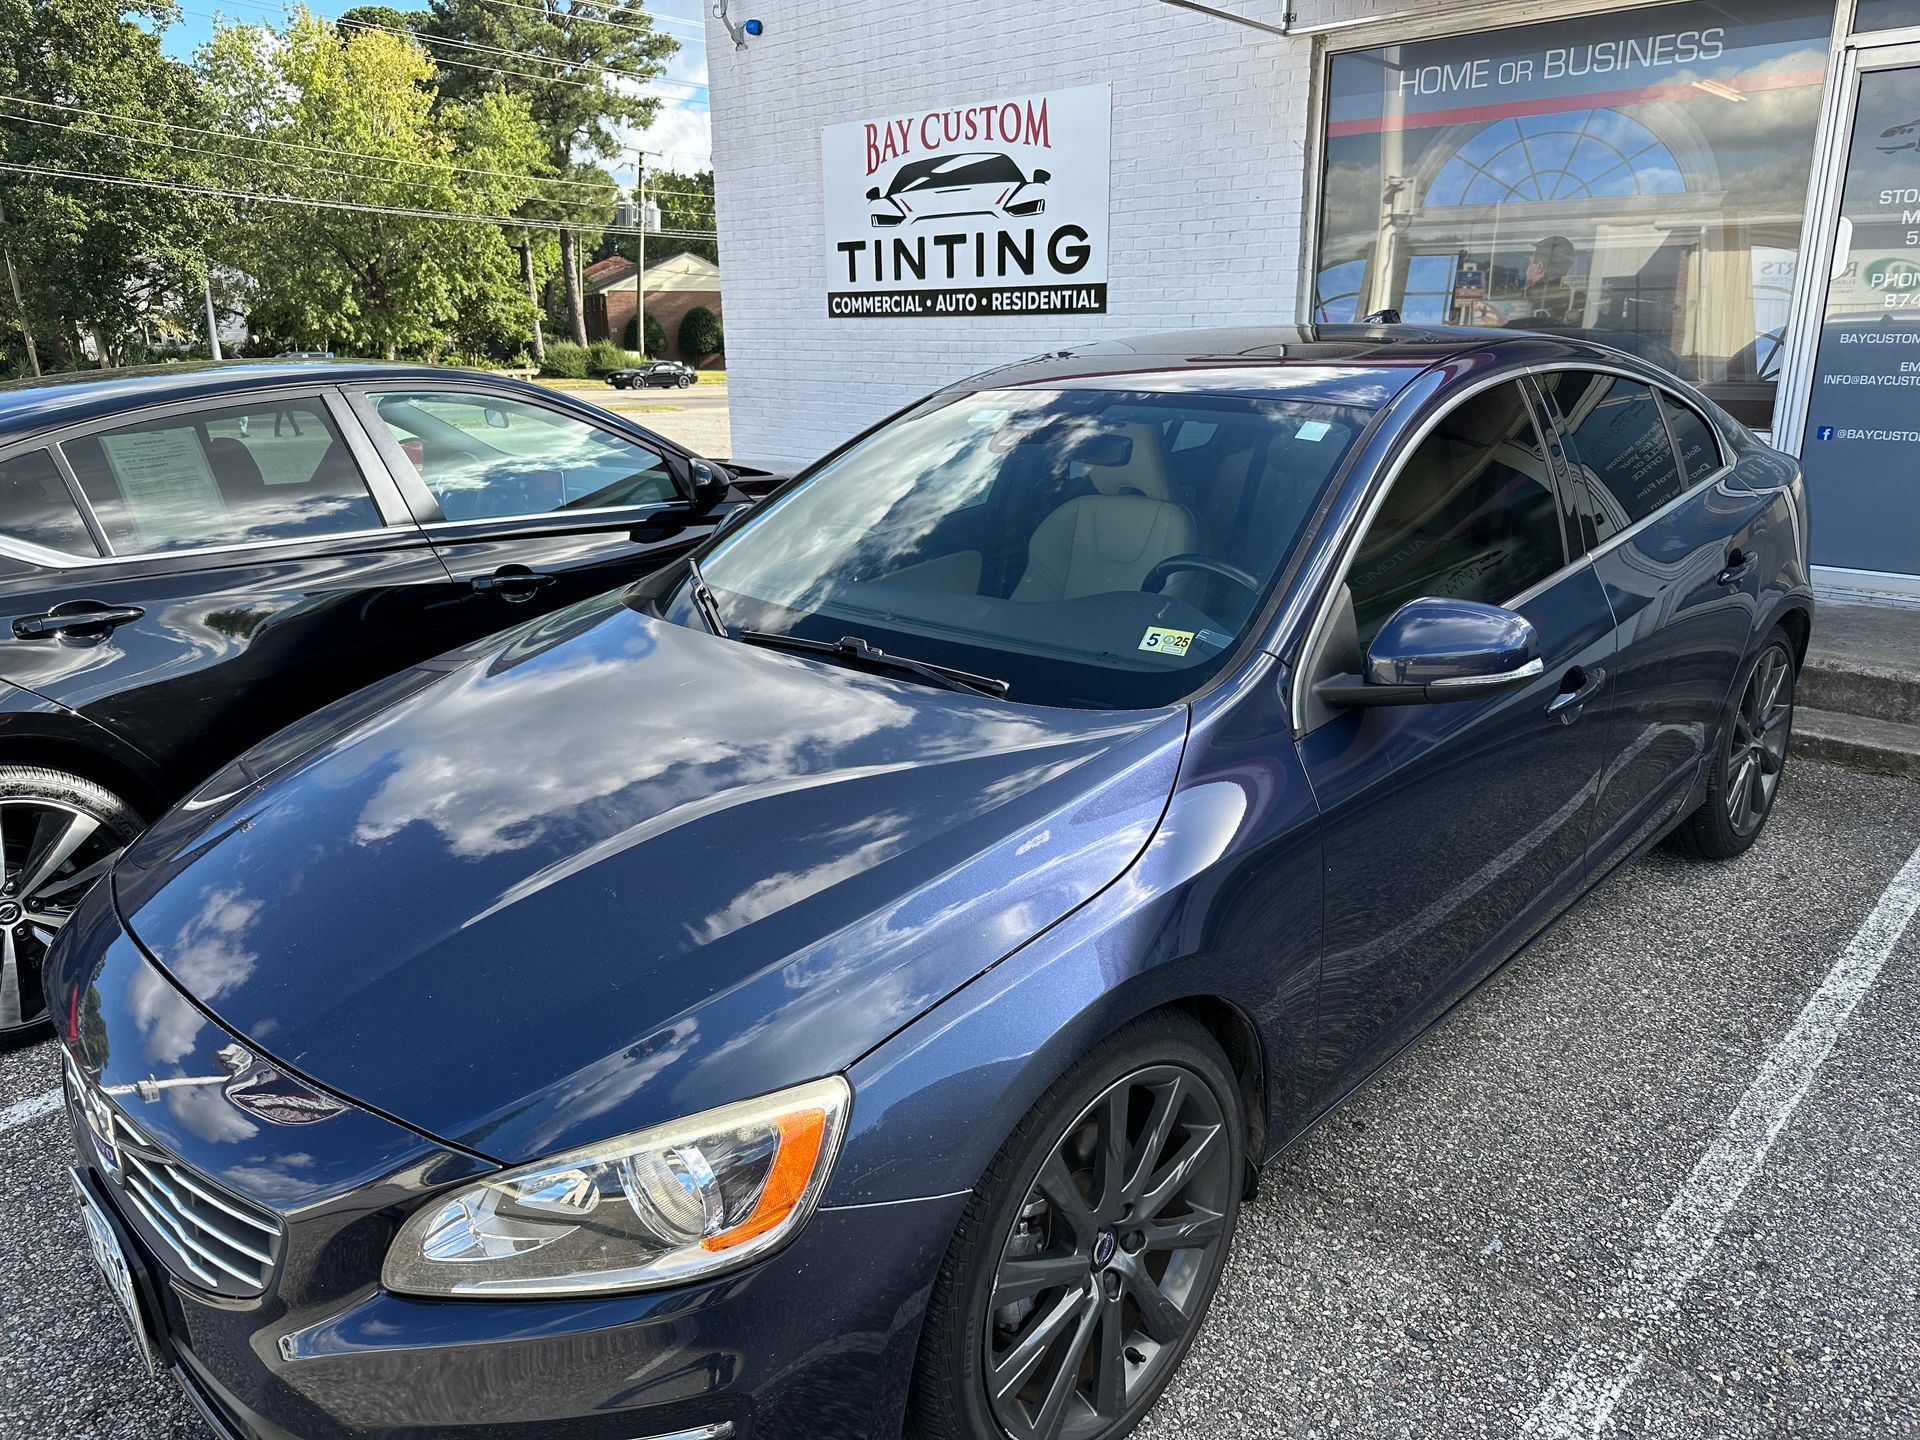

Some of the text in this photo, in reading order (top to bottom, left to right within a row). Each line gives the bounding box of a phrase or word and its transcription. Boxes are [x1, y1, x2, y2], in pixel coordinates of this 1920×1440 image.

[1399, 27, 1725, 97] HOME OR BUSINESS
[864, 97, 1051, 176] BAY CUSTOM
[1879, 188, 1920, 205] STO
[837, 224, 1091, 282] TINTING
[832, 289, 1100, 314] COMMERCIAL AUTO RESIDENTIAL
[1837, 429, 1920, 442] @BAYCUSTO
[1146, 633, 1190, 648] 5 25
